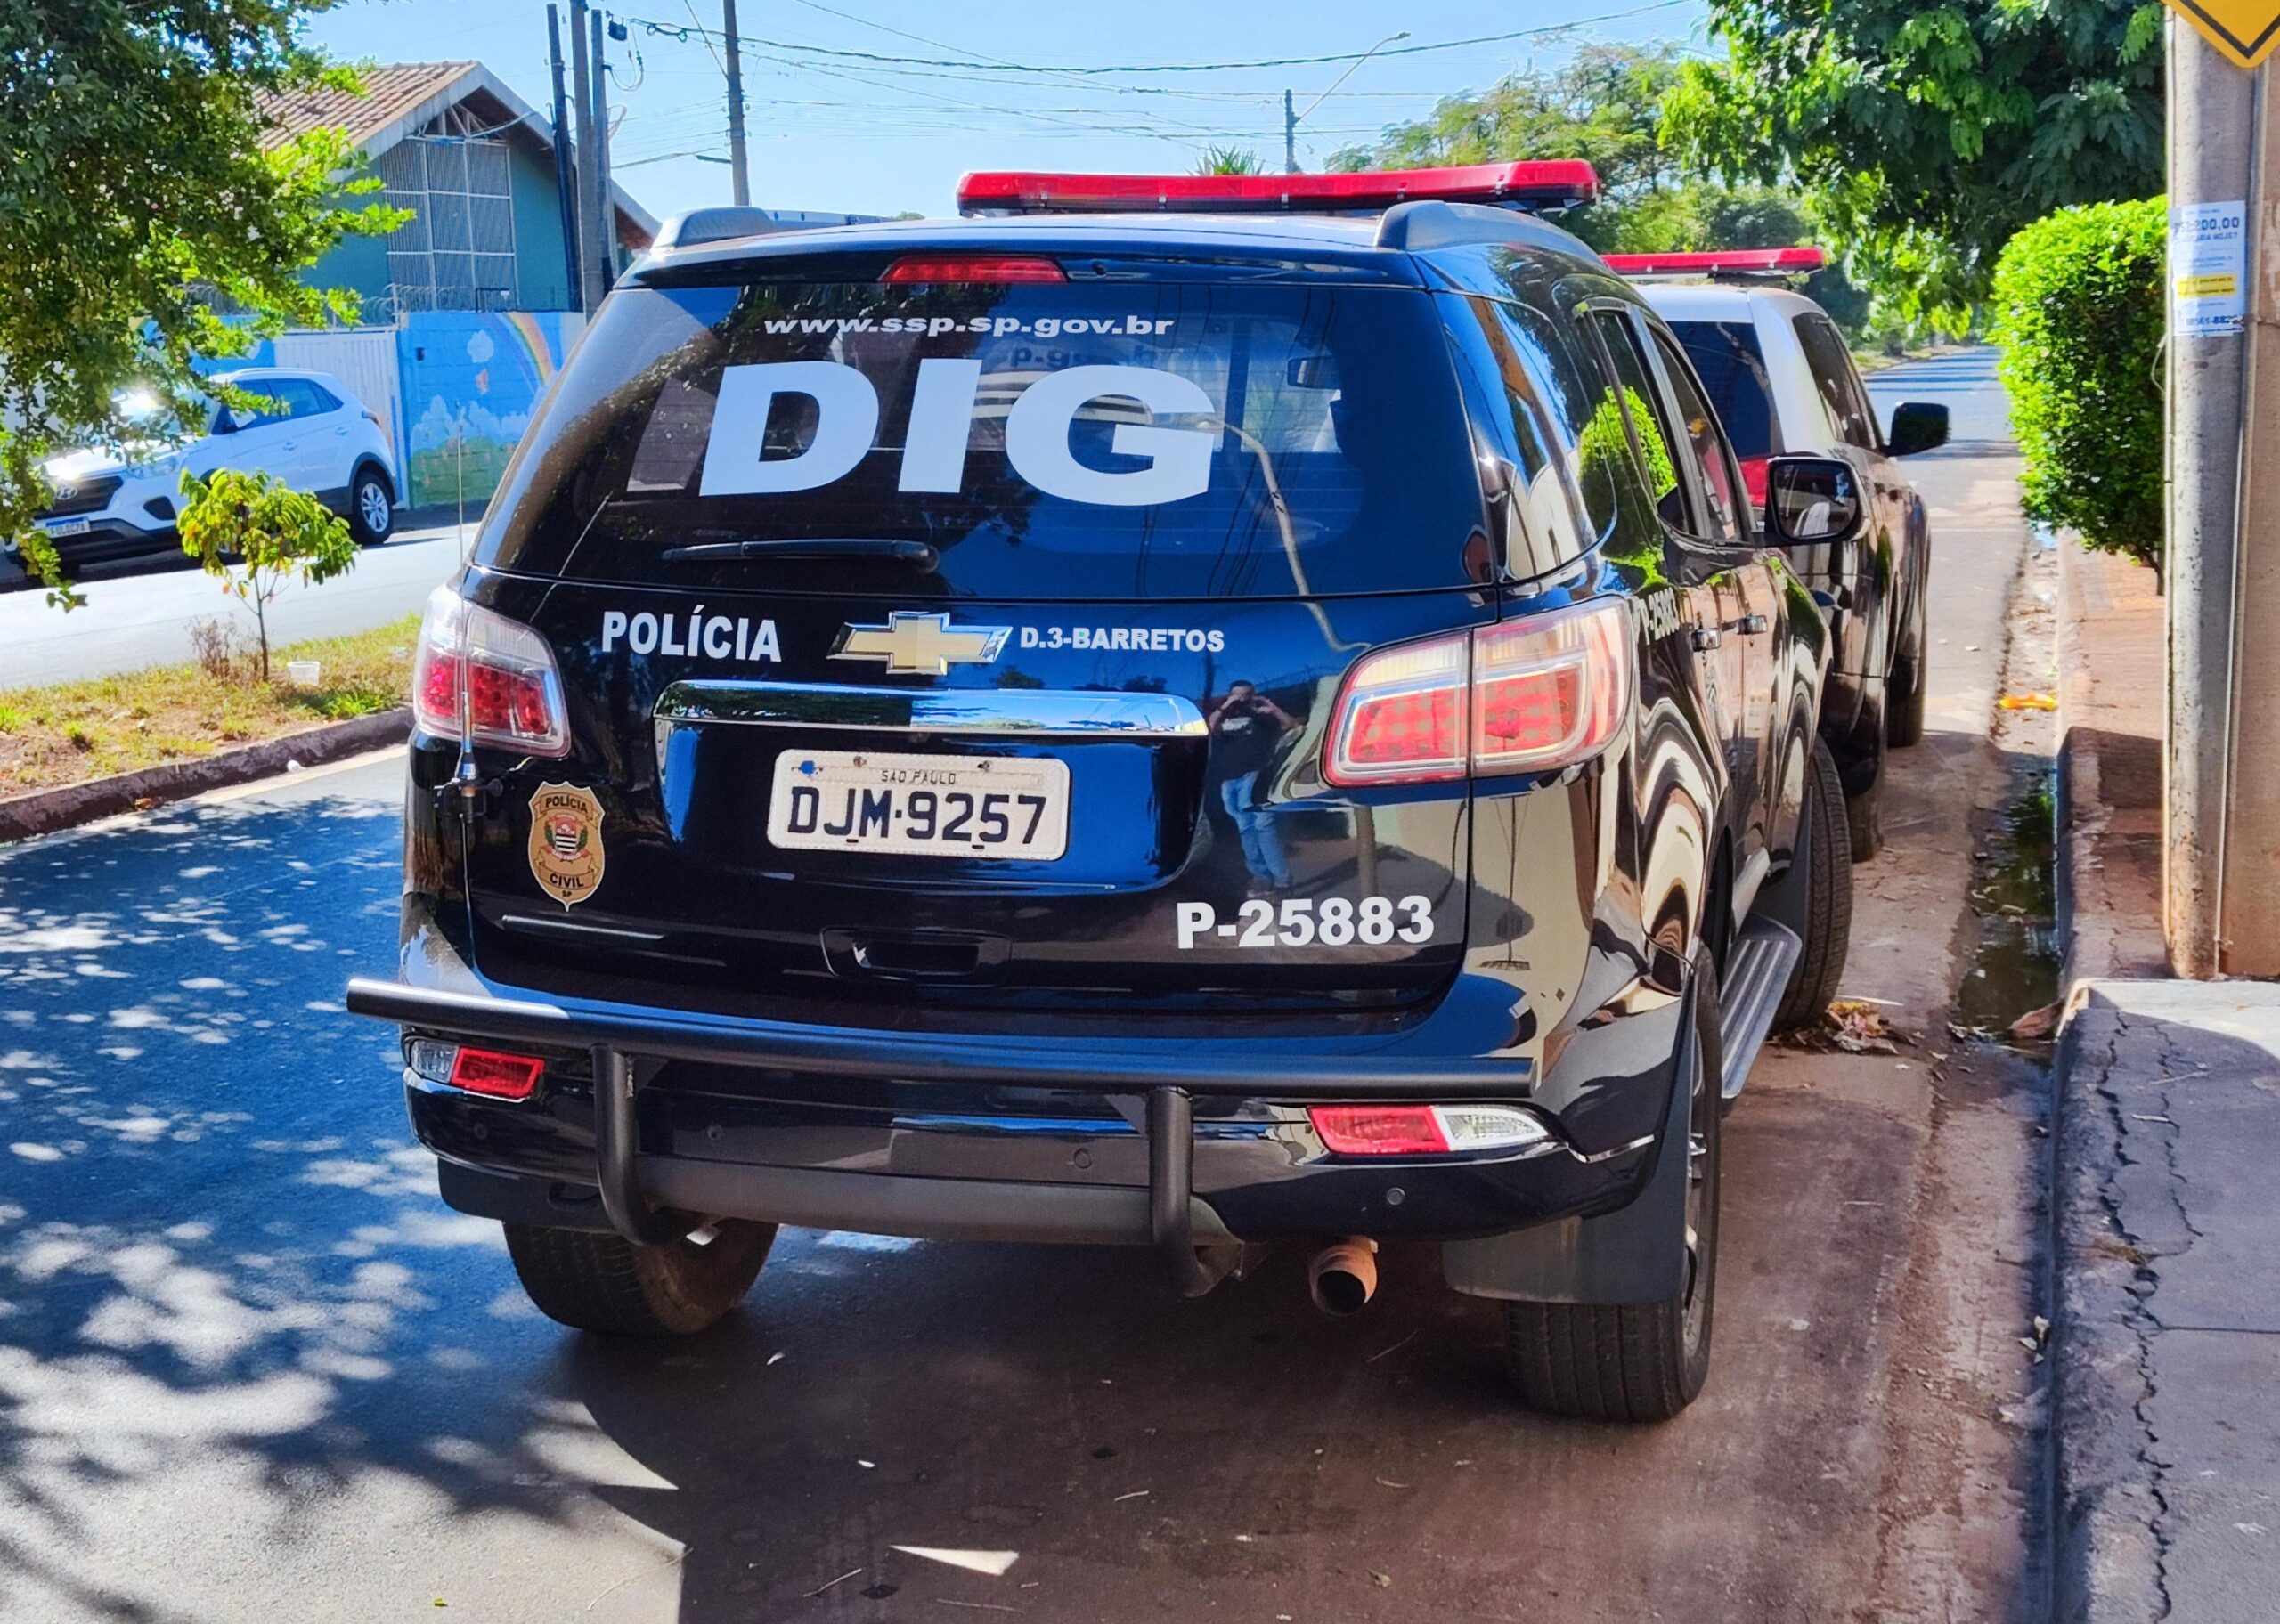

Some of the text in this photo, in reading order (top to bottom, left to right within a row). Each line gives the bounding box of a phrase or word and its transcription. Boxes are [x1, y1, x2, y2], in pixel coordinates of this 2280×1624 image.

[763, 314, 1175, 337] www.ssp.sp.gov.br
[699, 358, 1217, 506] DIG
[601, 604, 782, 662] POLÍCIA
[1020, 626, 1226, 653] D.3-BARRETOS
[909, 769, 957, 785] PAULO
[544, 793, 589, 814] POLÍCIA
[550, 872, 584, 889] CIVIL
[562, 890, 572, 898] SP
[1177, 895, 1435, 949] P-25883
